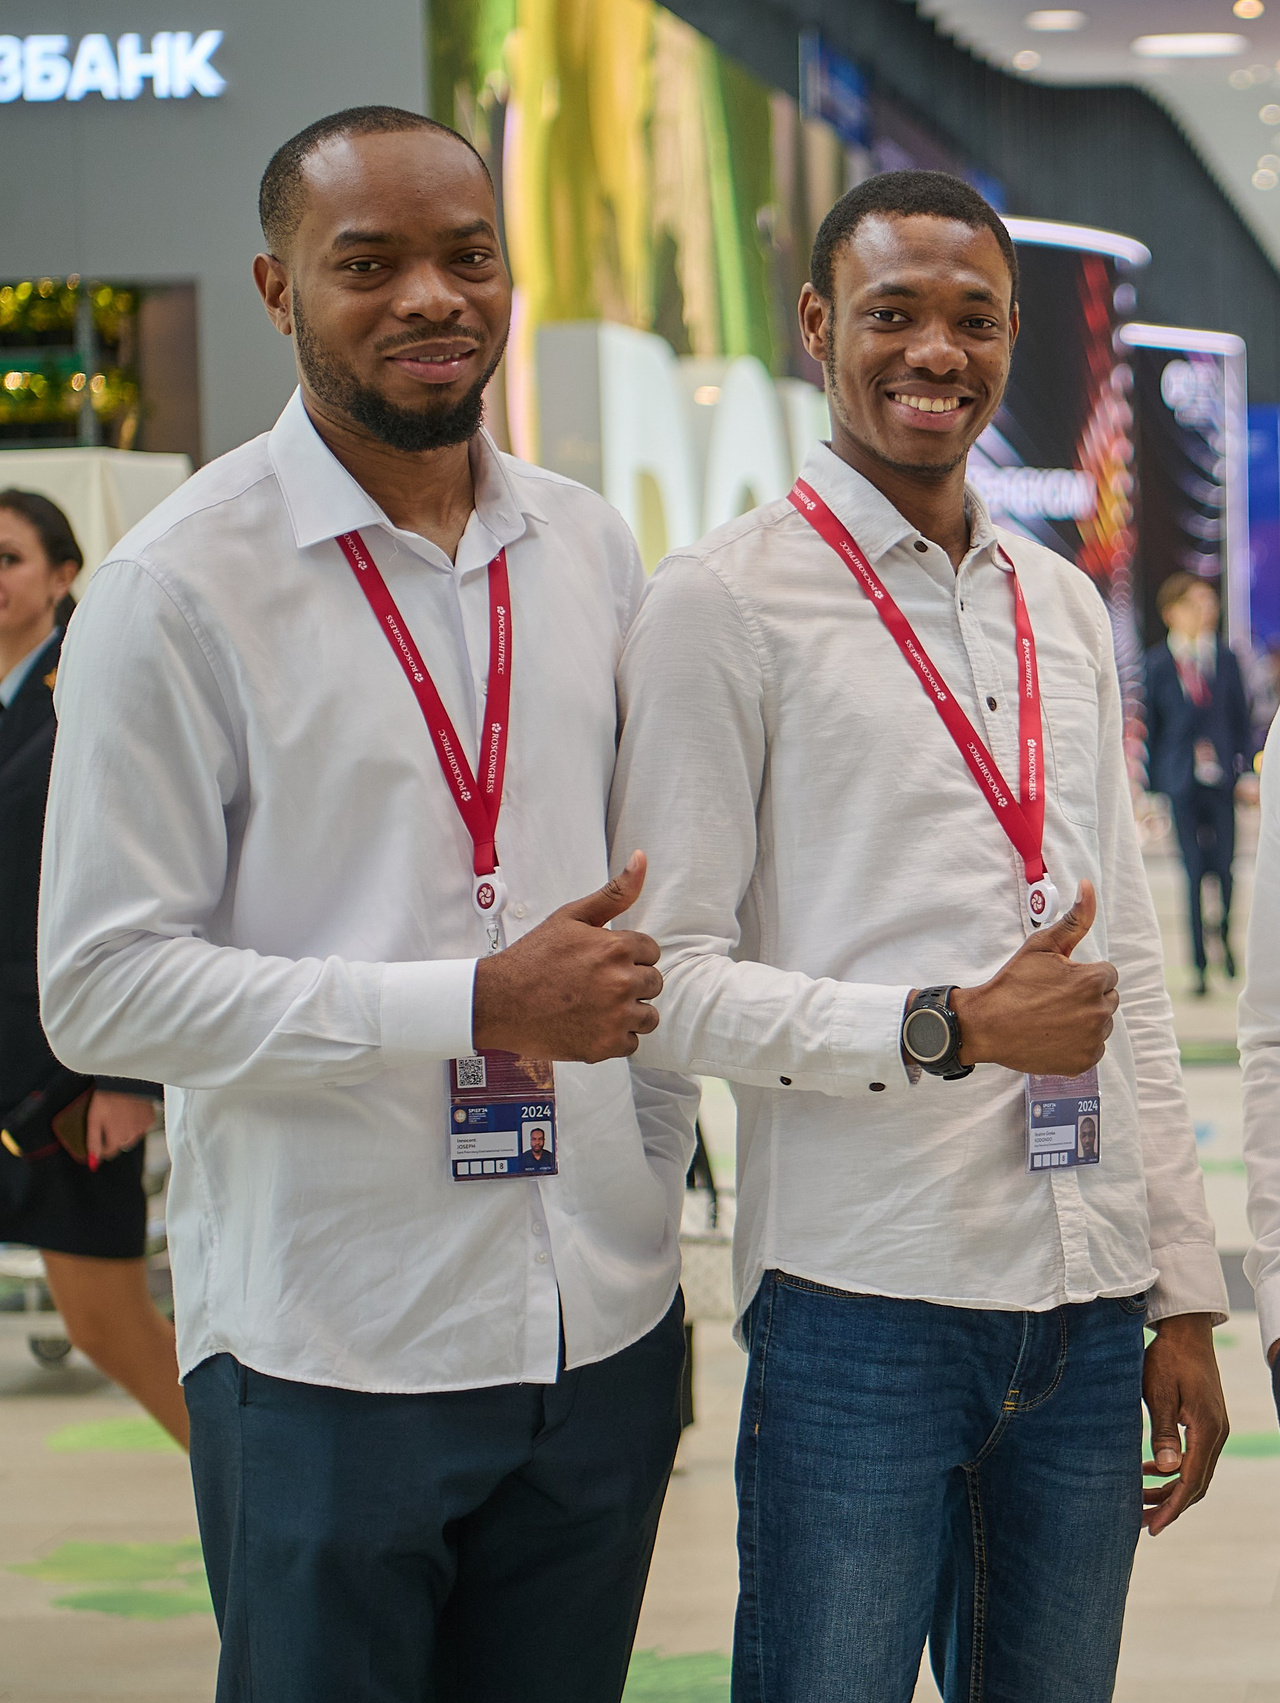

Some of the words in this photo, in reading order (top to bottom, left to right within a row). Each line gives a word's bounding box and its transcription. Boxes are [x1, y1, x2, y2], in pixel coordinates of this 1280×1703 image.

[343, 533, 361, 562] РОСКО
[839, 540, 878, 592] РОСКОНГРЕСС
[386, 614, 419, 674] ROSCONGRESS
[498, 615, 506, 675] РОСКОНГРЕСС
[904, 638, 941, 694] ROSCONGRESS
[438, 728, 467, 792] РОСКОНГРЕСС
[486, 732, 499, 794] ROSCONGRESS
[967, 741, 1001, 800] РОСКОНГРЕСС
[1028, 747, 1037, 801] ROSCONGRESS
[521, 1105, 551, 1118] 2024
[1078, 1100, 1098, 1112] 2024
